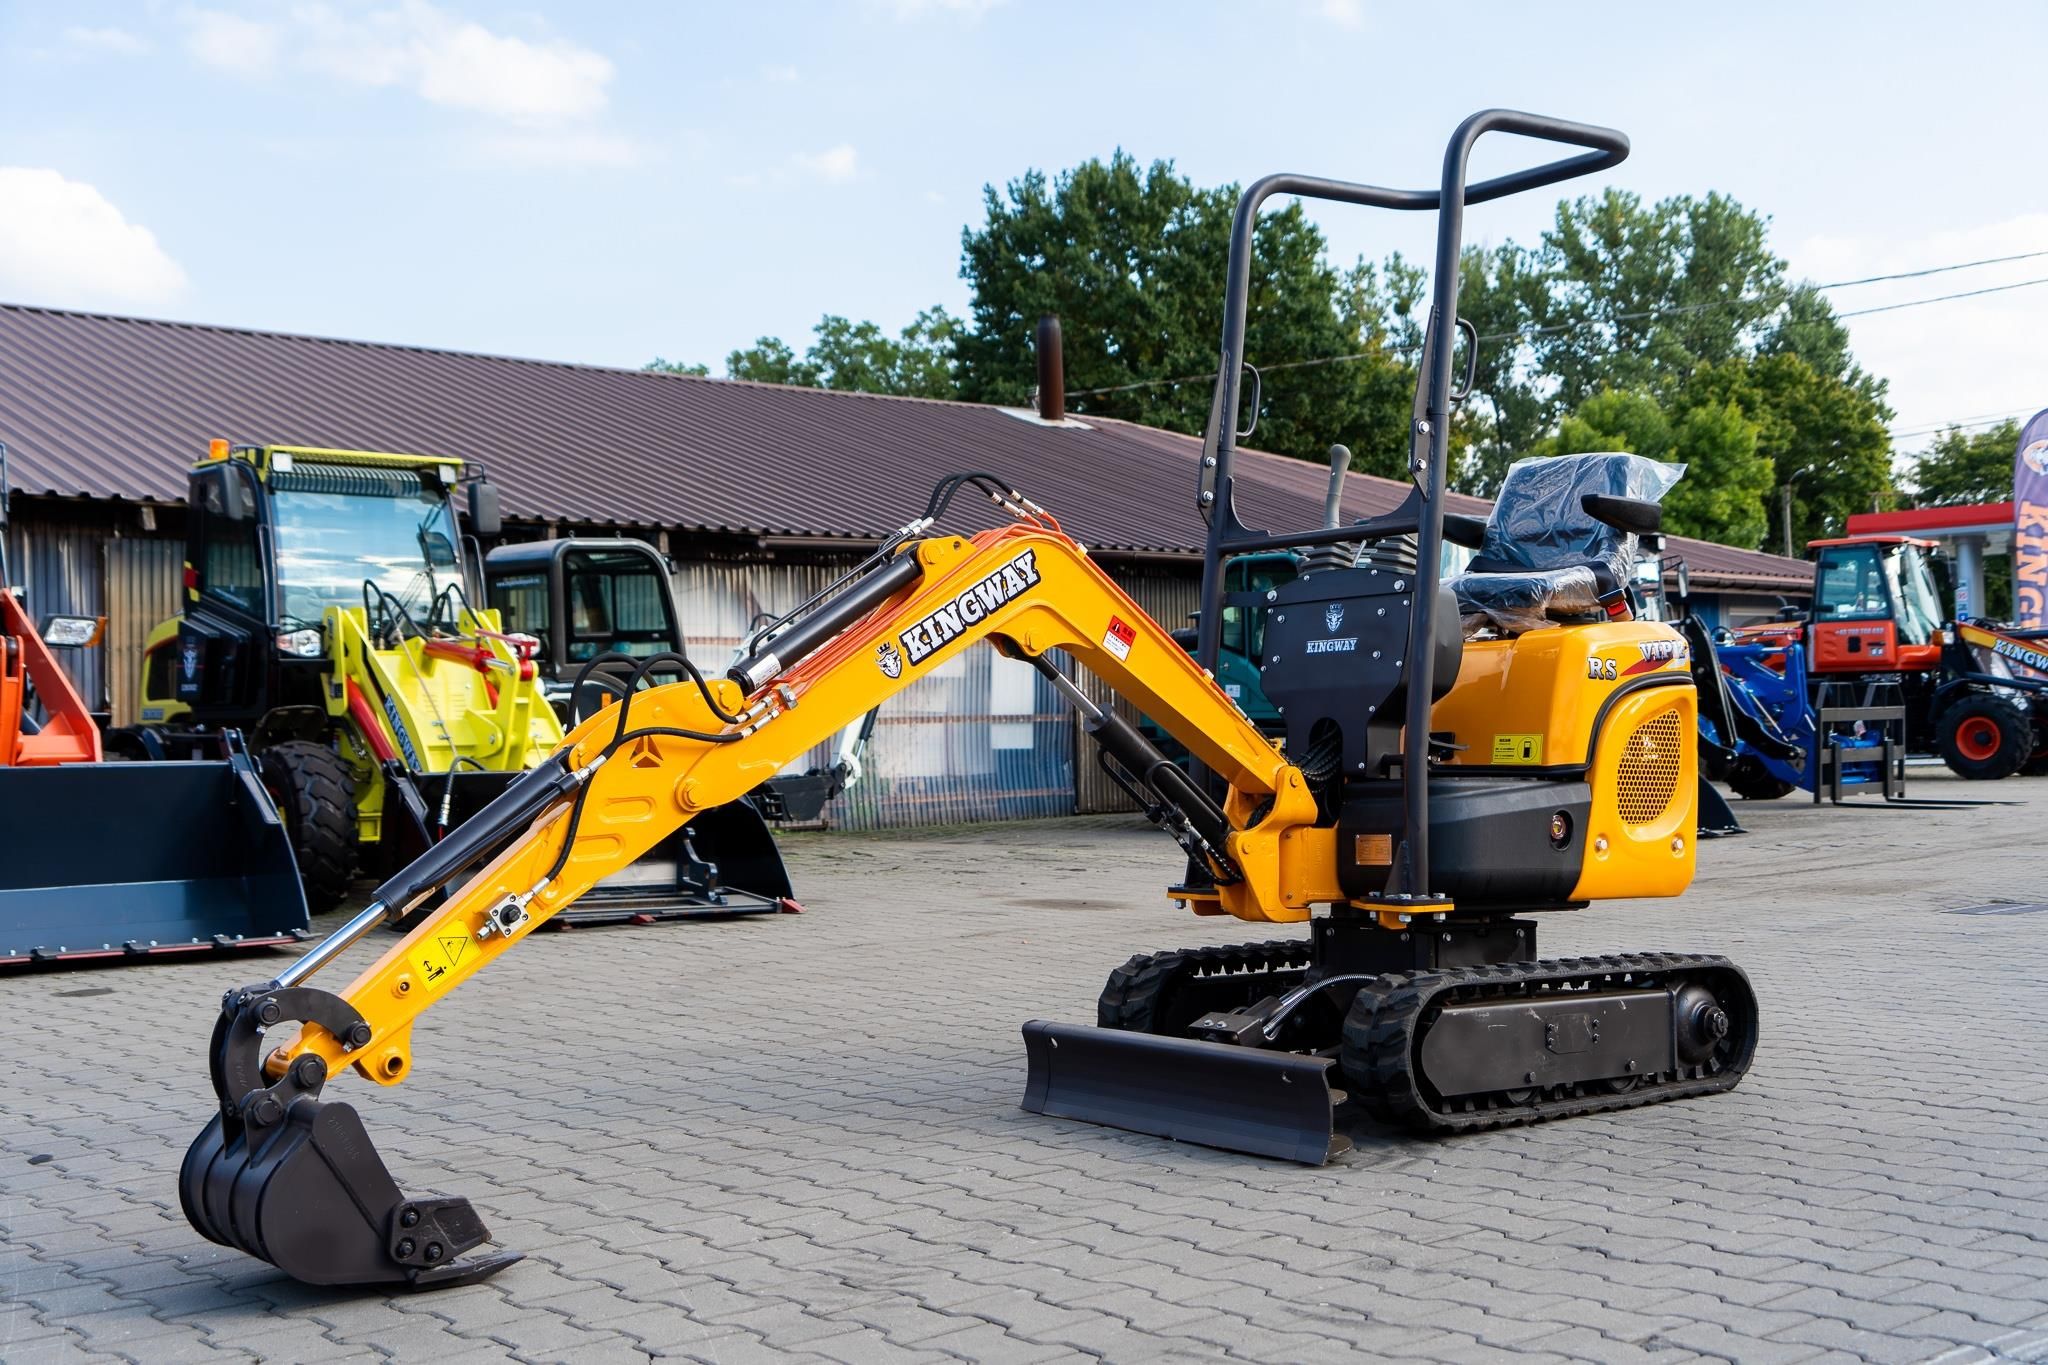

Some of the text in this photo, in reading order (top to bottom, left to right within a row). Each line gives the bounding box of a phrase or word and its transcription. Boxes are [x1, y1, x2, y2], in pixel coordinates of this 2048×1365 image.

[2016, 500, 2048, 631] KING
[900, 549, 1041, 666] KINGWAY
[1306, 638, 1358, 653] KINGWAY
[1588, 656, 1617, 680] RS
